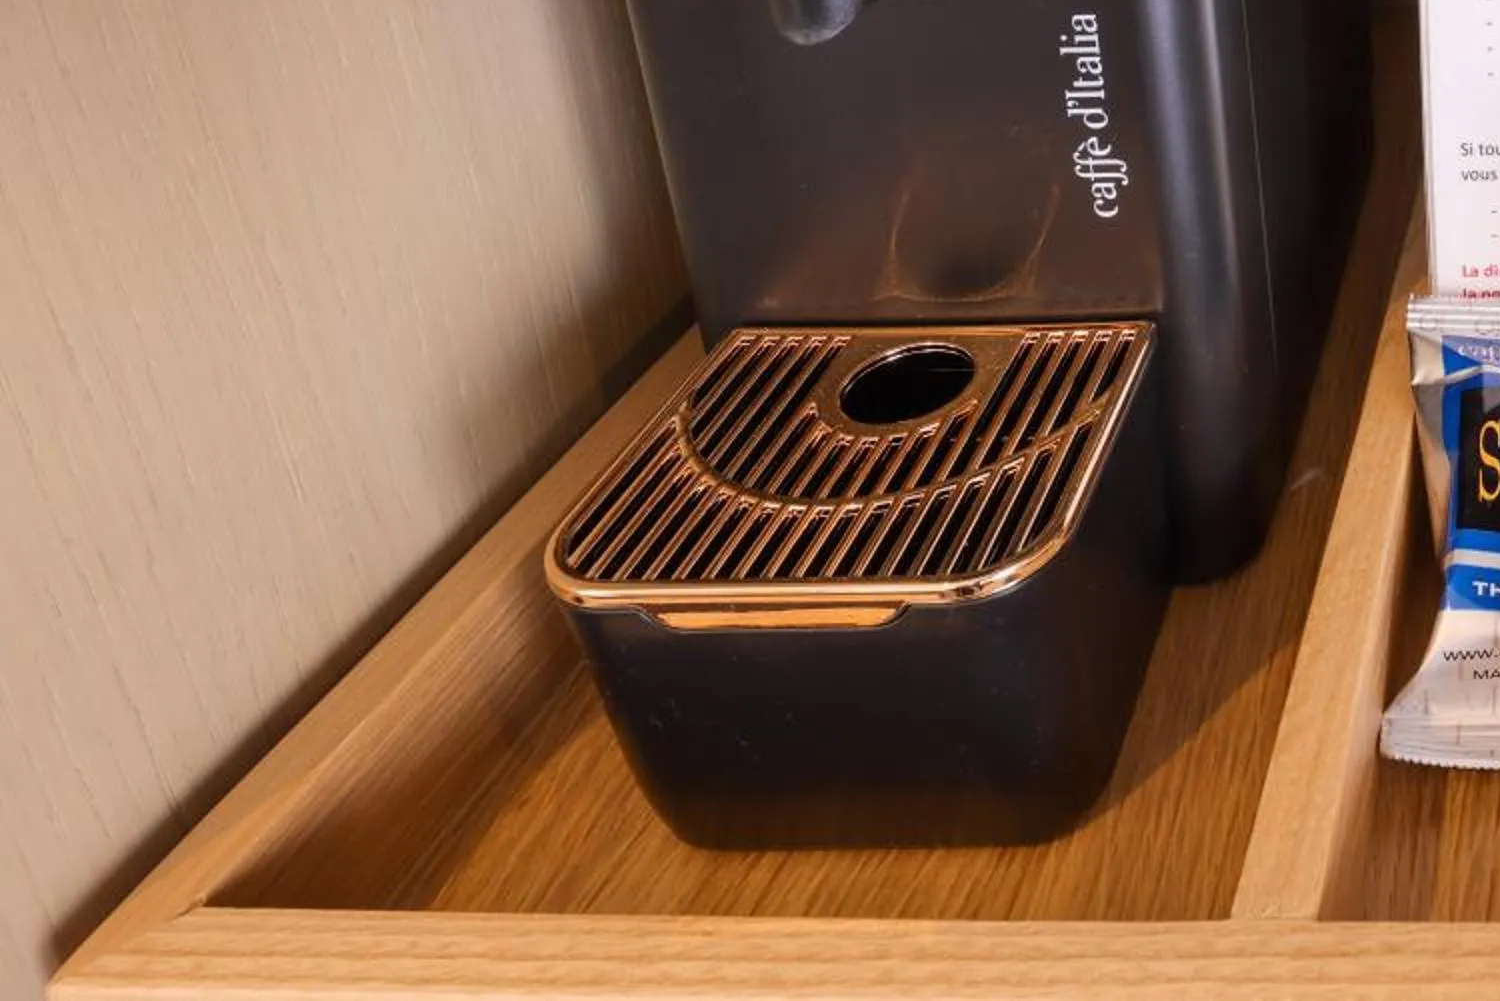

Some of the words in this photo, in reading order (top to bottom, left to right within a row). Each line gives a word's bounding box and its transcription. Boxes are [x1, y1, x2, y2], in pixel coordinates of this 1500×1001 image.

[1059, 14, 1109, 129] d'Italia
[1459, 142, 1475, 157] Si
[1073, 136, 1128, 218] caffè
[1461, 169, 1498, 182] vous
[1461, 266, 1480, 278] La
